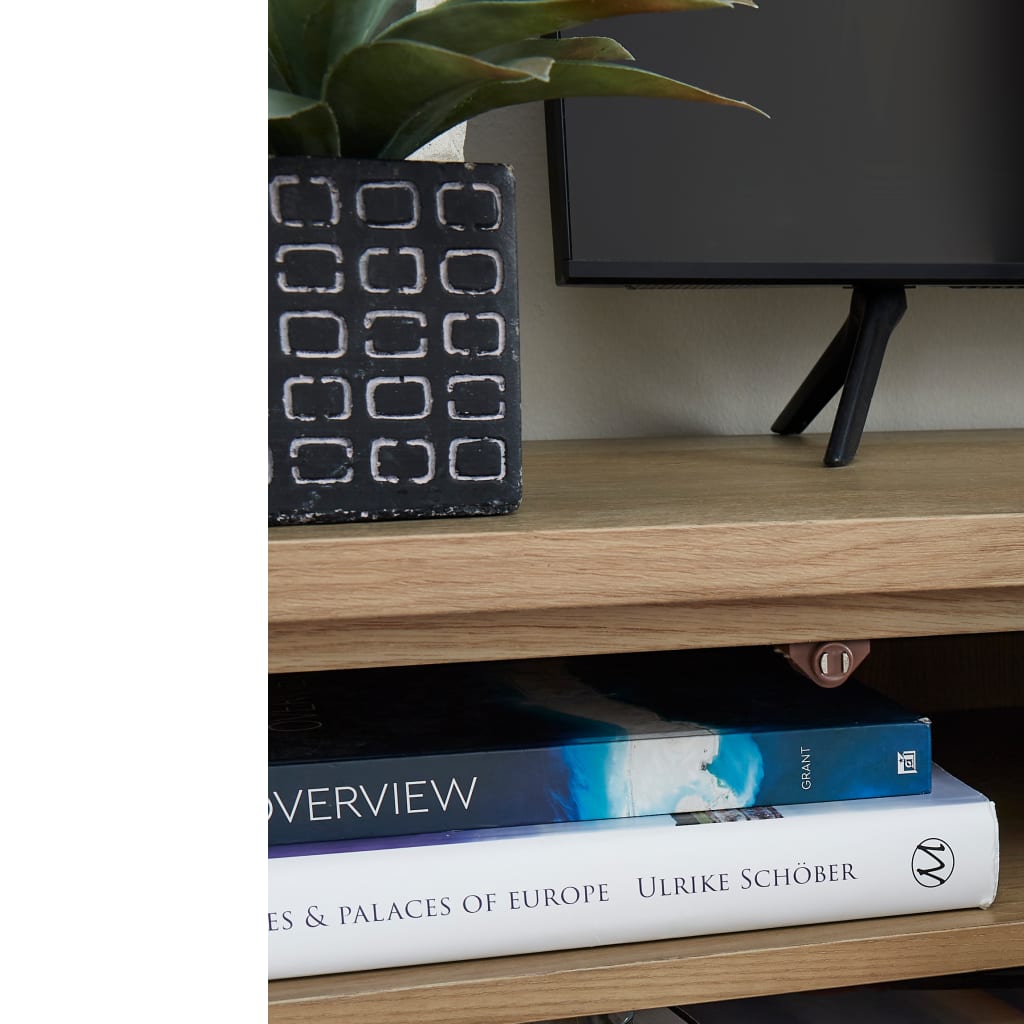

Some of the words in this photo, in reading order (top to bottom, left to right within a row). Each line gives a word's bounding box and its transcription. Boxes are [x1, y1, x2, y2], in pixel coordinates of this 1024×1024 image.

[801, 745, 813, 791] GRANT
[268, 776, 477, 823] VERVIEW
[305, 905, 328, 928] &
[340, 897, 451, 925] PALACES
[462, 893, 496, 914] OF
[509, 883, 609, 910] EUROPE
